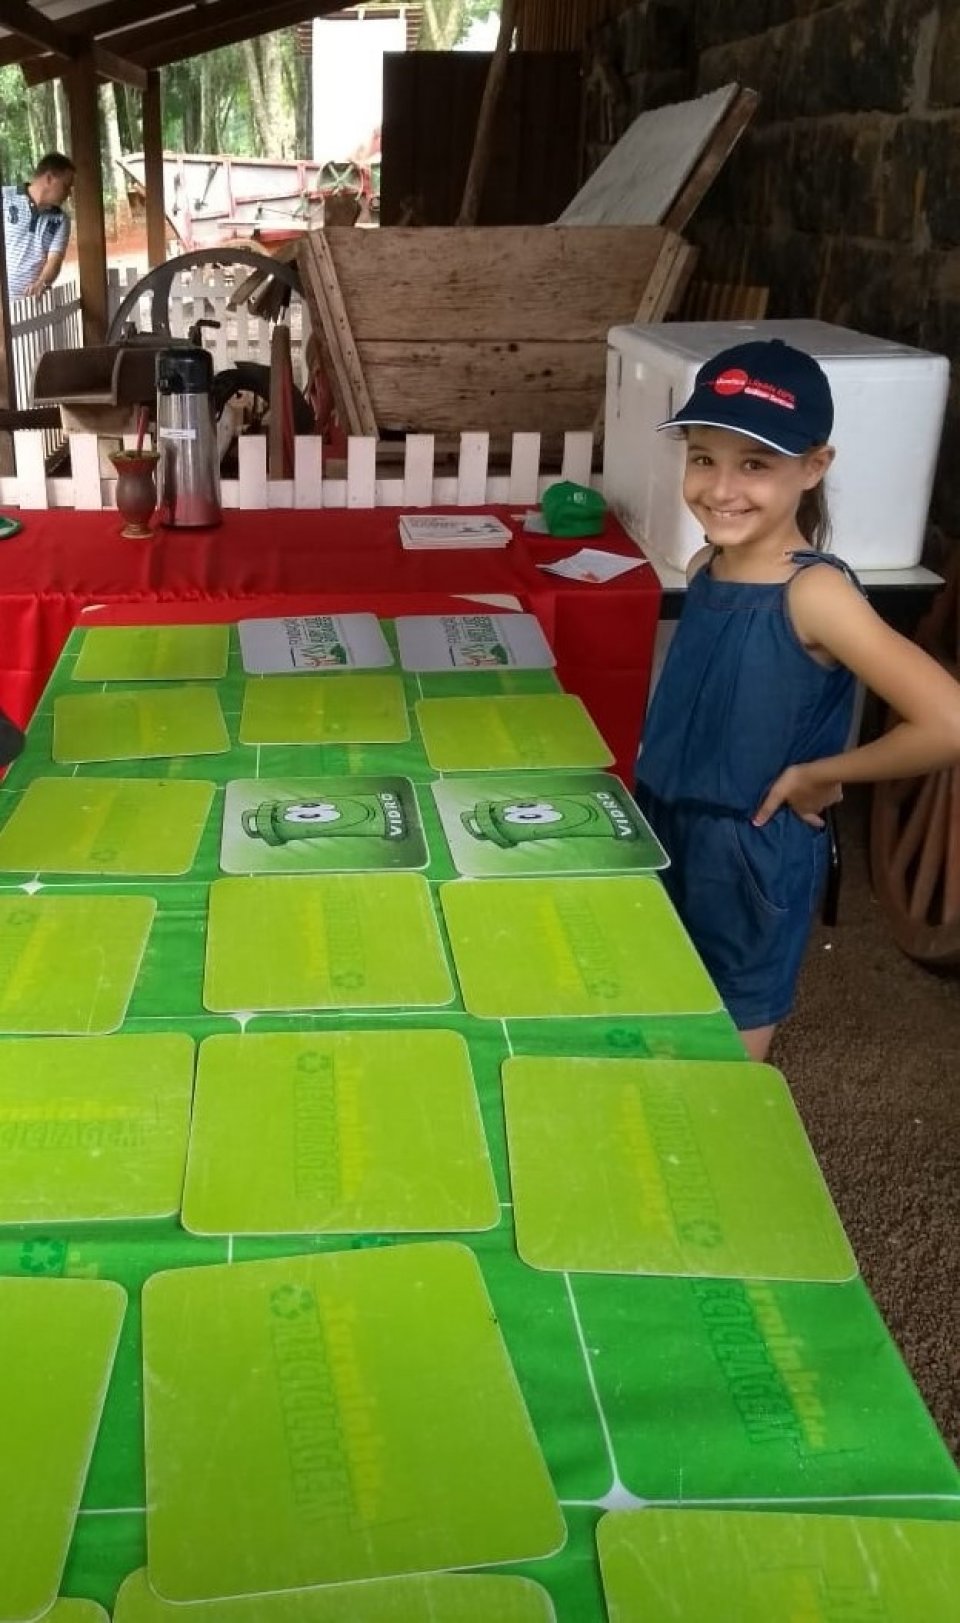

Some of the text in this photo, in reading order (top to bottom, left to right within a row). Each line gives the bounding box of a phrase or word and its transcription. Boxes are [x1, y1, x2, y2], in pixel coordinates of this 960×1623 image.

[381, 793, 402, 836] VIDRO
[596, 793, 632, 836] VIDRO
[693, 1283, 799, 1444] ECICLAGEM
